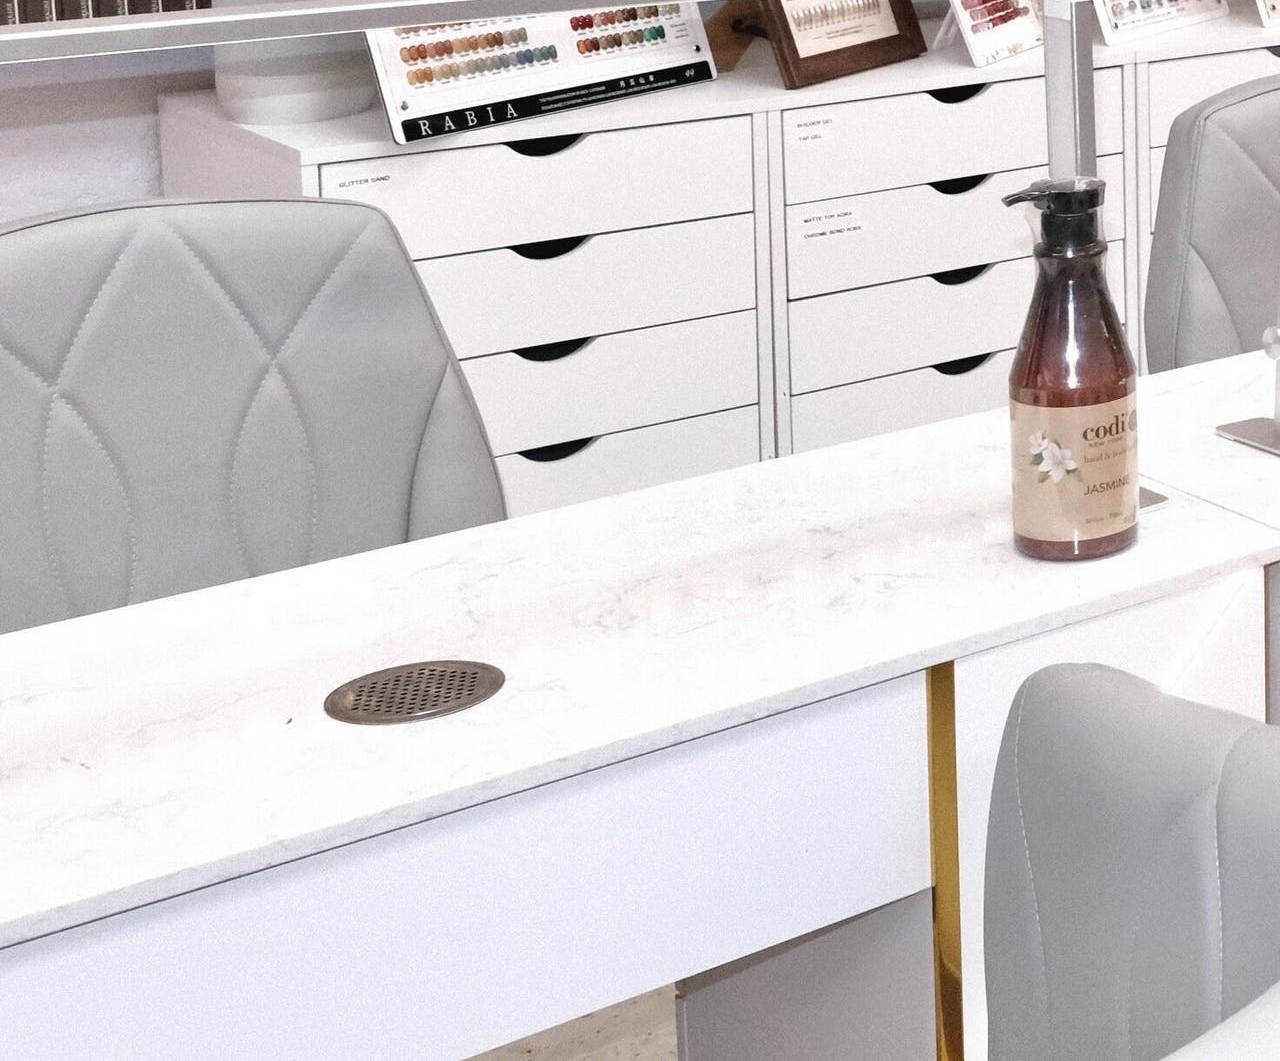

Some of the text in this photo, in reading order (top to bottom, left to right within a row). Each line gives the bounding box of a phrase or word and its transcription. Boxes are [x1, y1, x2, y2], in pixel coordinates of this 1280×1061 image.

[419, 102, 518, 136] RABIA
[339, 175, 391, 188] GLITTER SAND
[1083, 413, 1125, 442] codi
